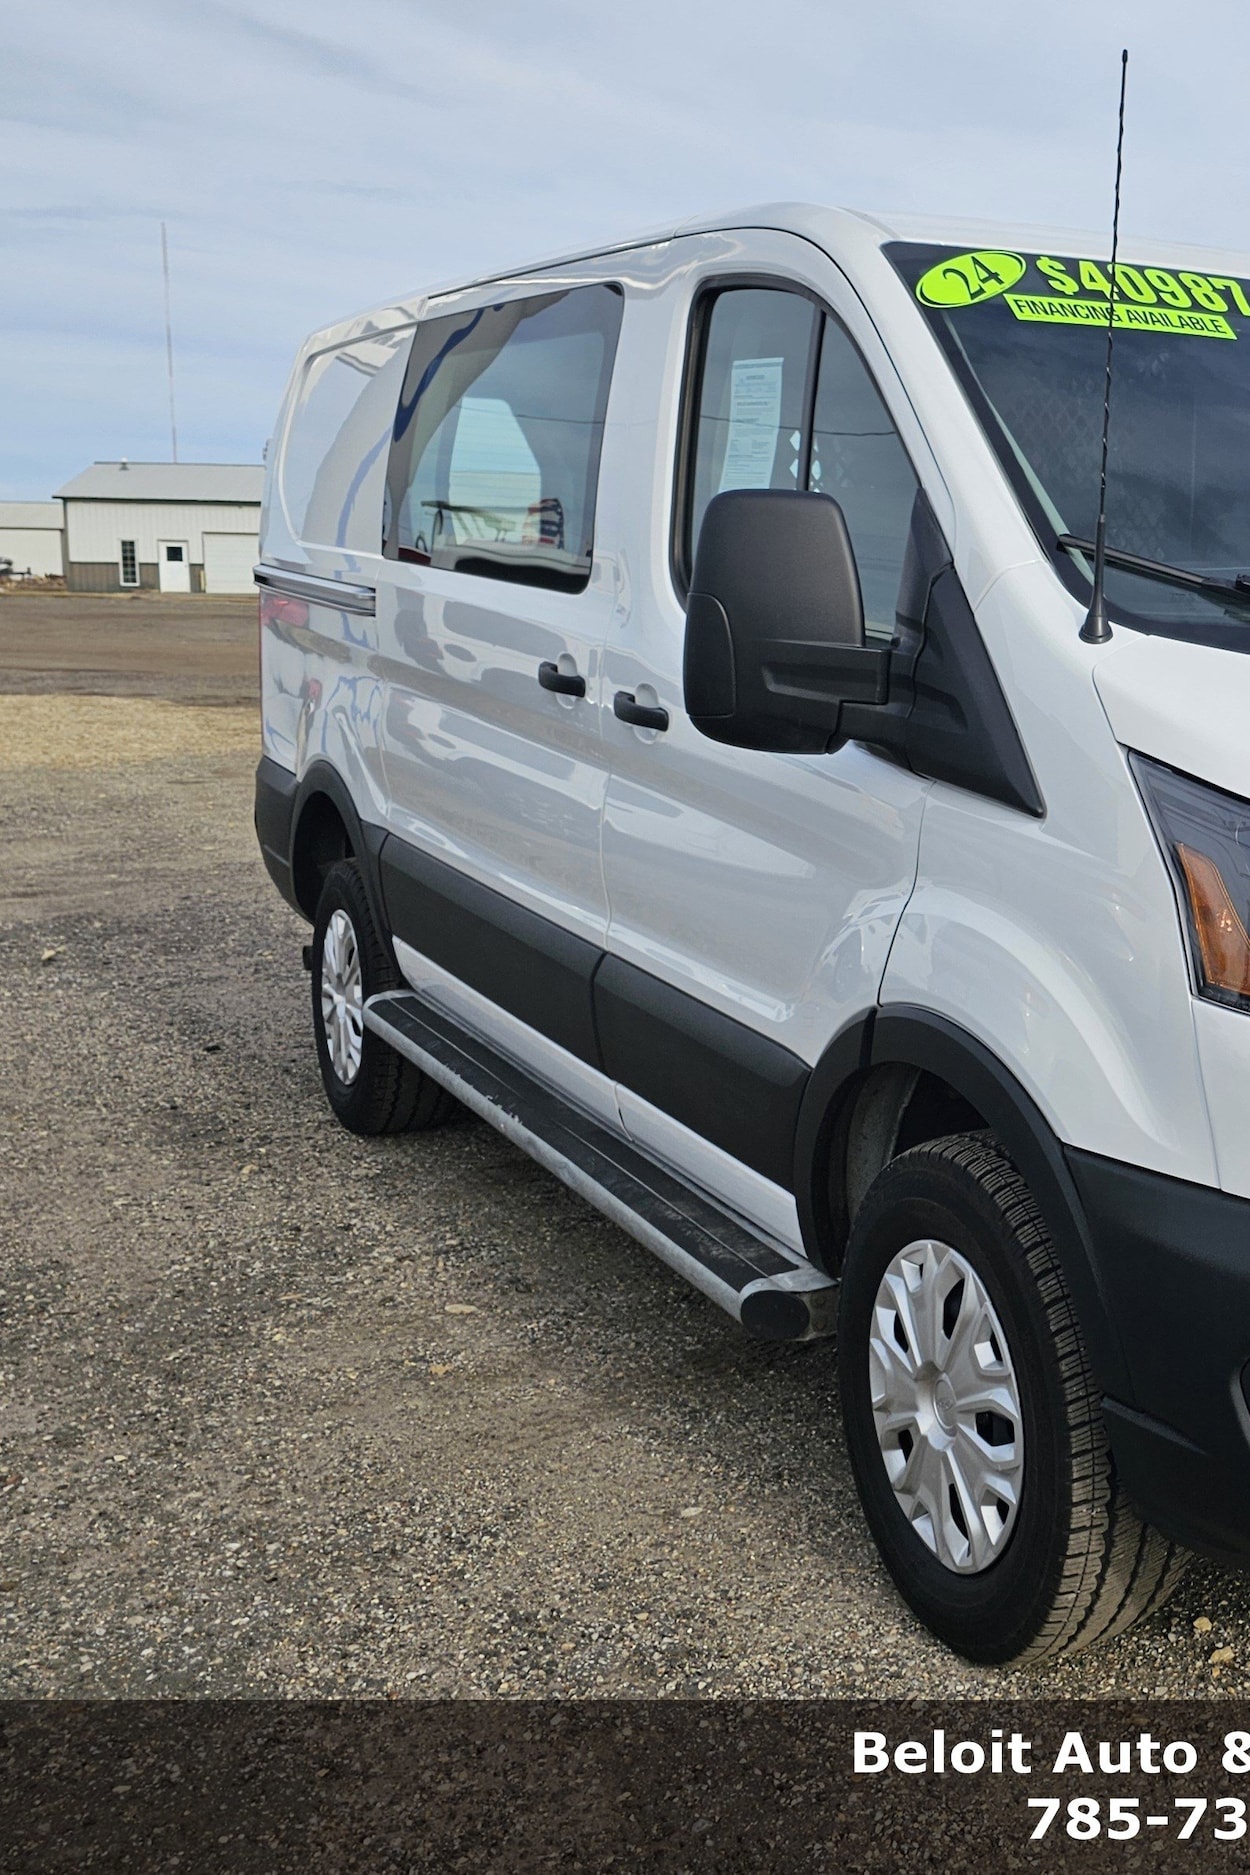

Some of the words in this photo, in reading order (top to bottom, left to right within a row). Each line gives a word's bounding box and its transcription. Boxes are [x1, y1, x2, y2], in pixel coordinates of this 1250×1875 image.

[942, 255, 1004, 300] 24
[1014, 299, 1121, 323] FINANCING
[1120, 308, 1228, 335] AVAILABLE
